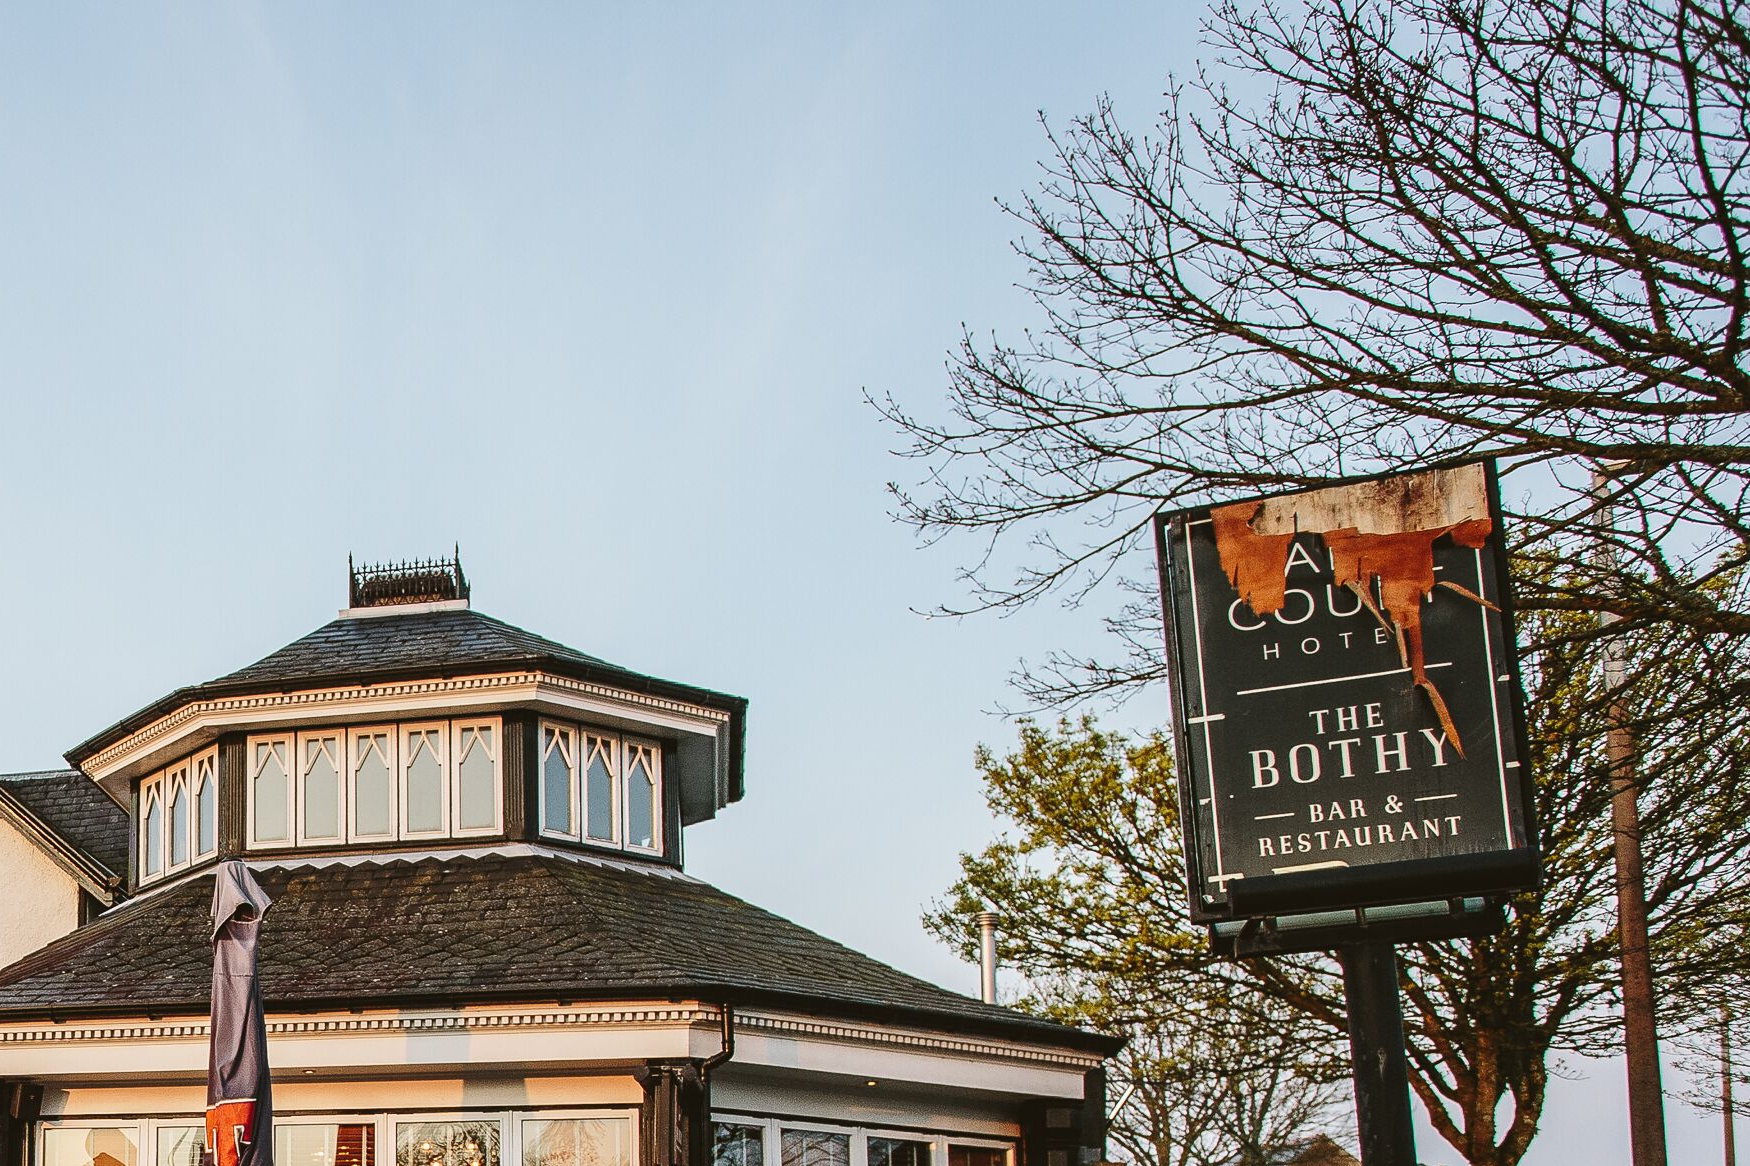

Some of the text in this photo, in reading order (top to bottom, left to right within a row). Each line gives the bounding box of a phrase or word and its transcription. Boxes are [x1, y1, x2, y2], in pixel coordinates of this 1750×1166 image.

[1228, 570, 1435, 631] COU
[1263, 625, 1390, 660] HOTE
[1309, 702, 1384, 735] THE
[1248, 727, 1450, 789] BOTHY
[1309, 794, 1404, 823] BAR &
[1258, 815, 1462, 857] RESTAURANT
